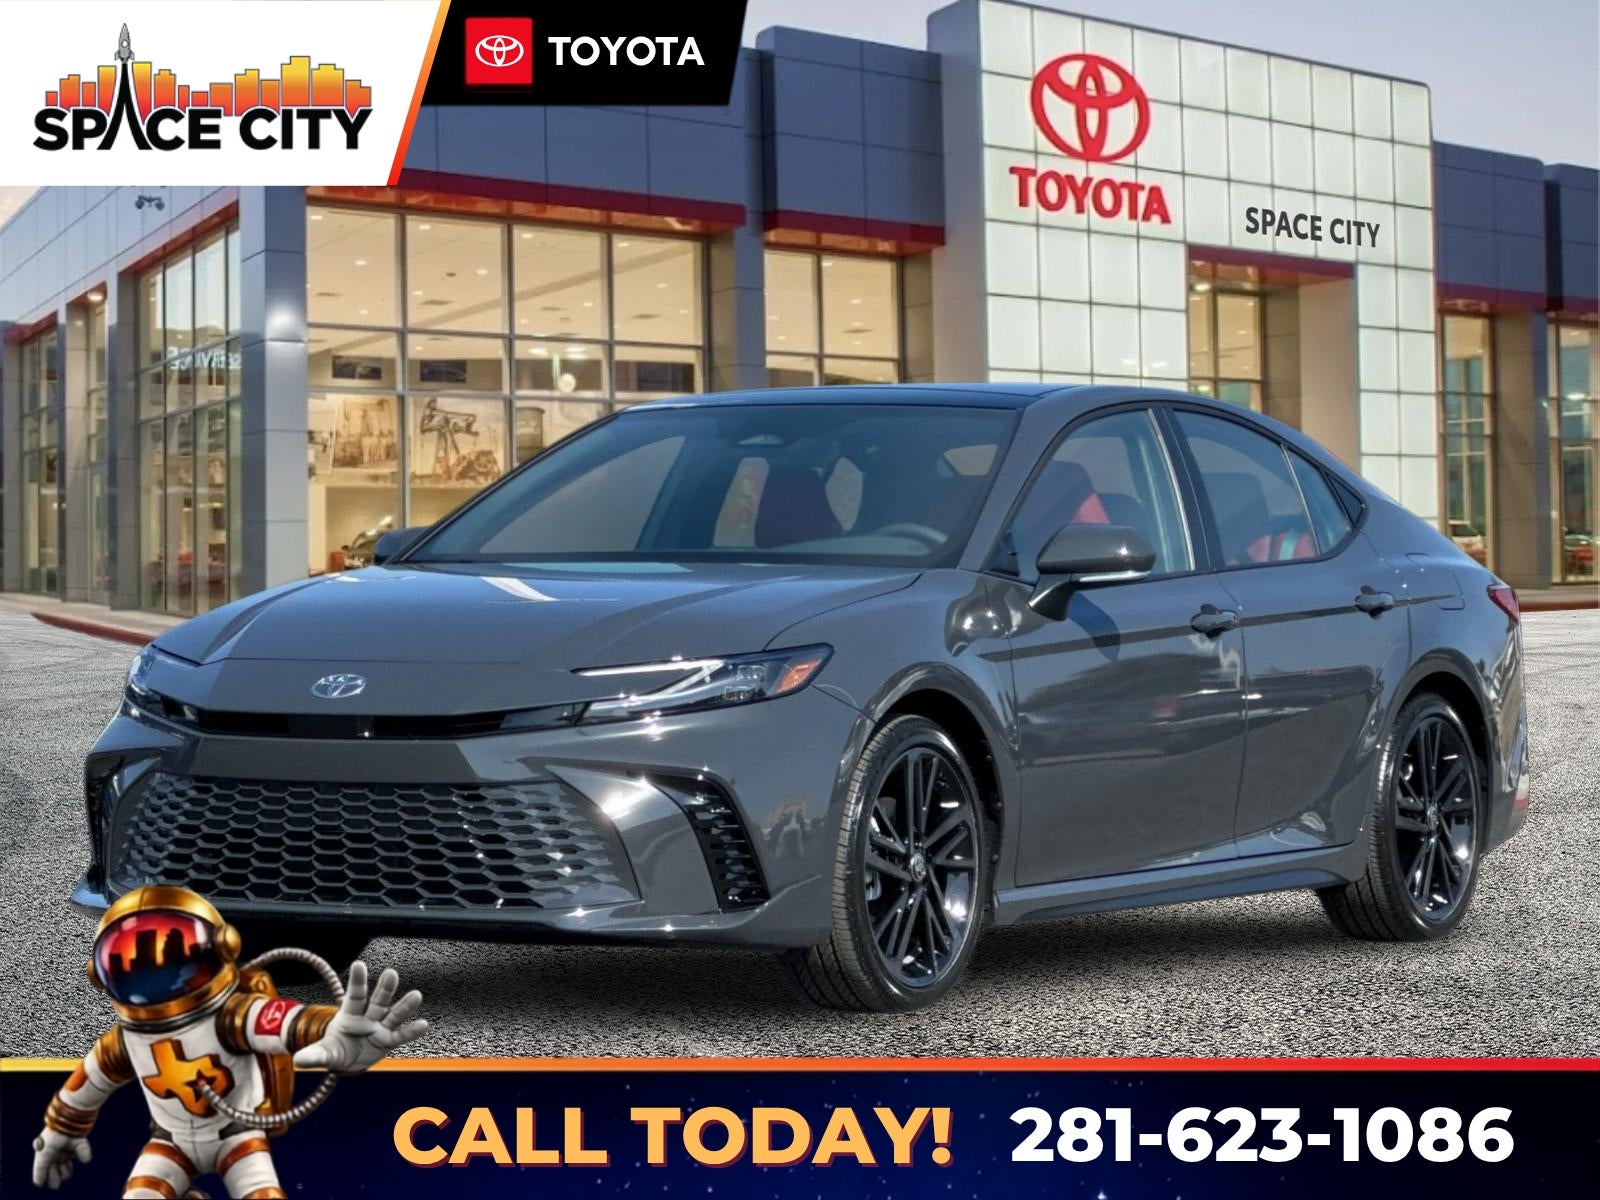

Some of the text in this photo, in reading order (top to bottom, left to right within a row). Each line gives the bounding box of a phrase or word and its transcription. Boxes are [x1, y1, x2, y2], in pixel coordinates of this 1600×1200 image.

[1009, 166, 1172, 225] TOYOTA
[1244, 206, 1381, 249] SPACE CITY
